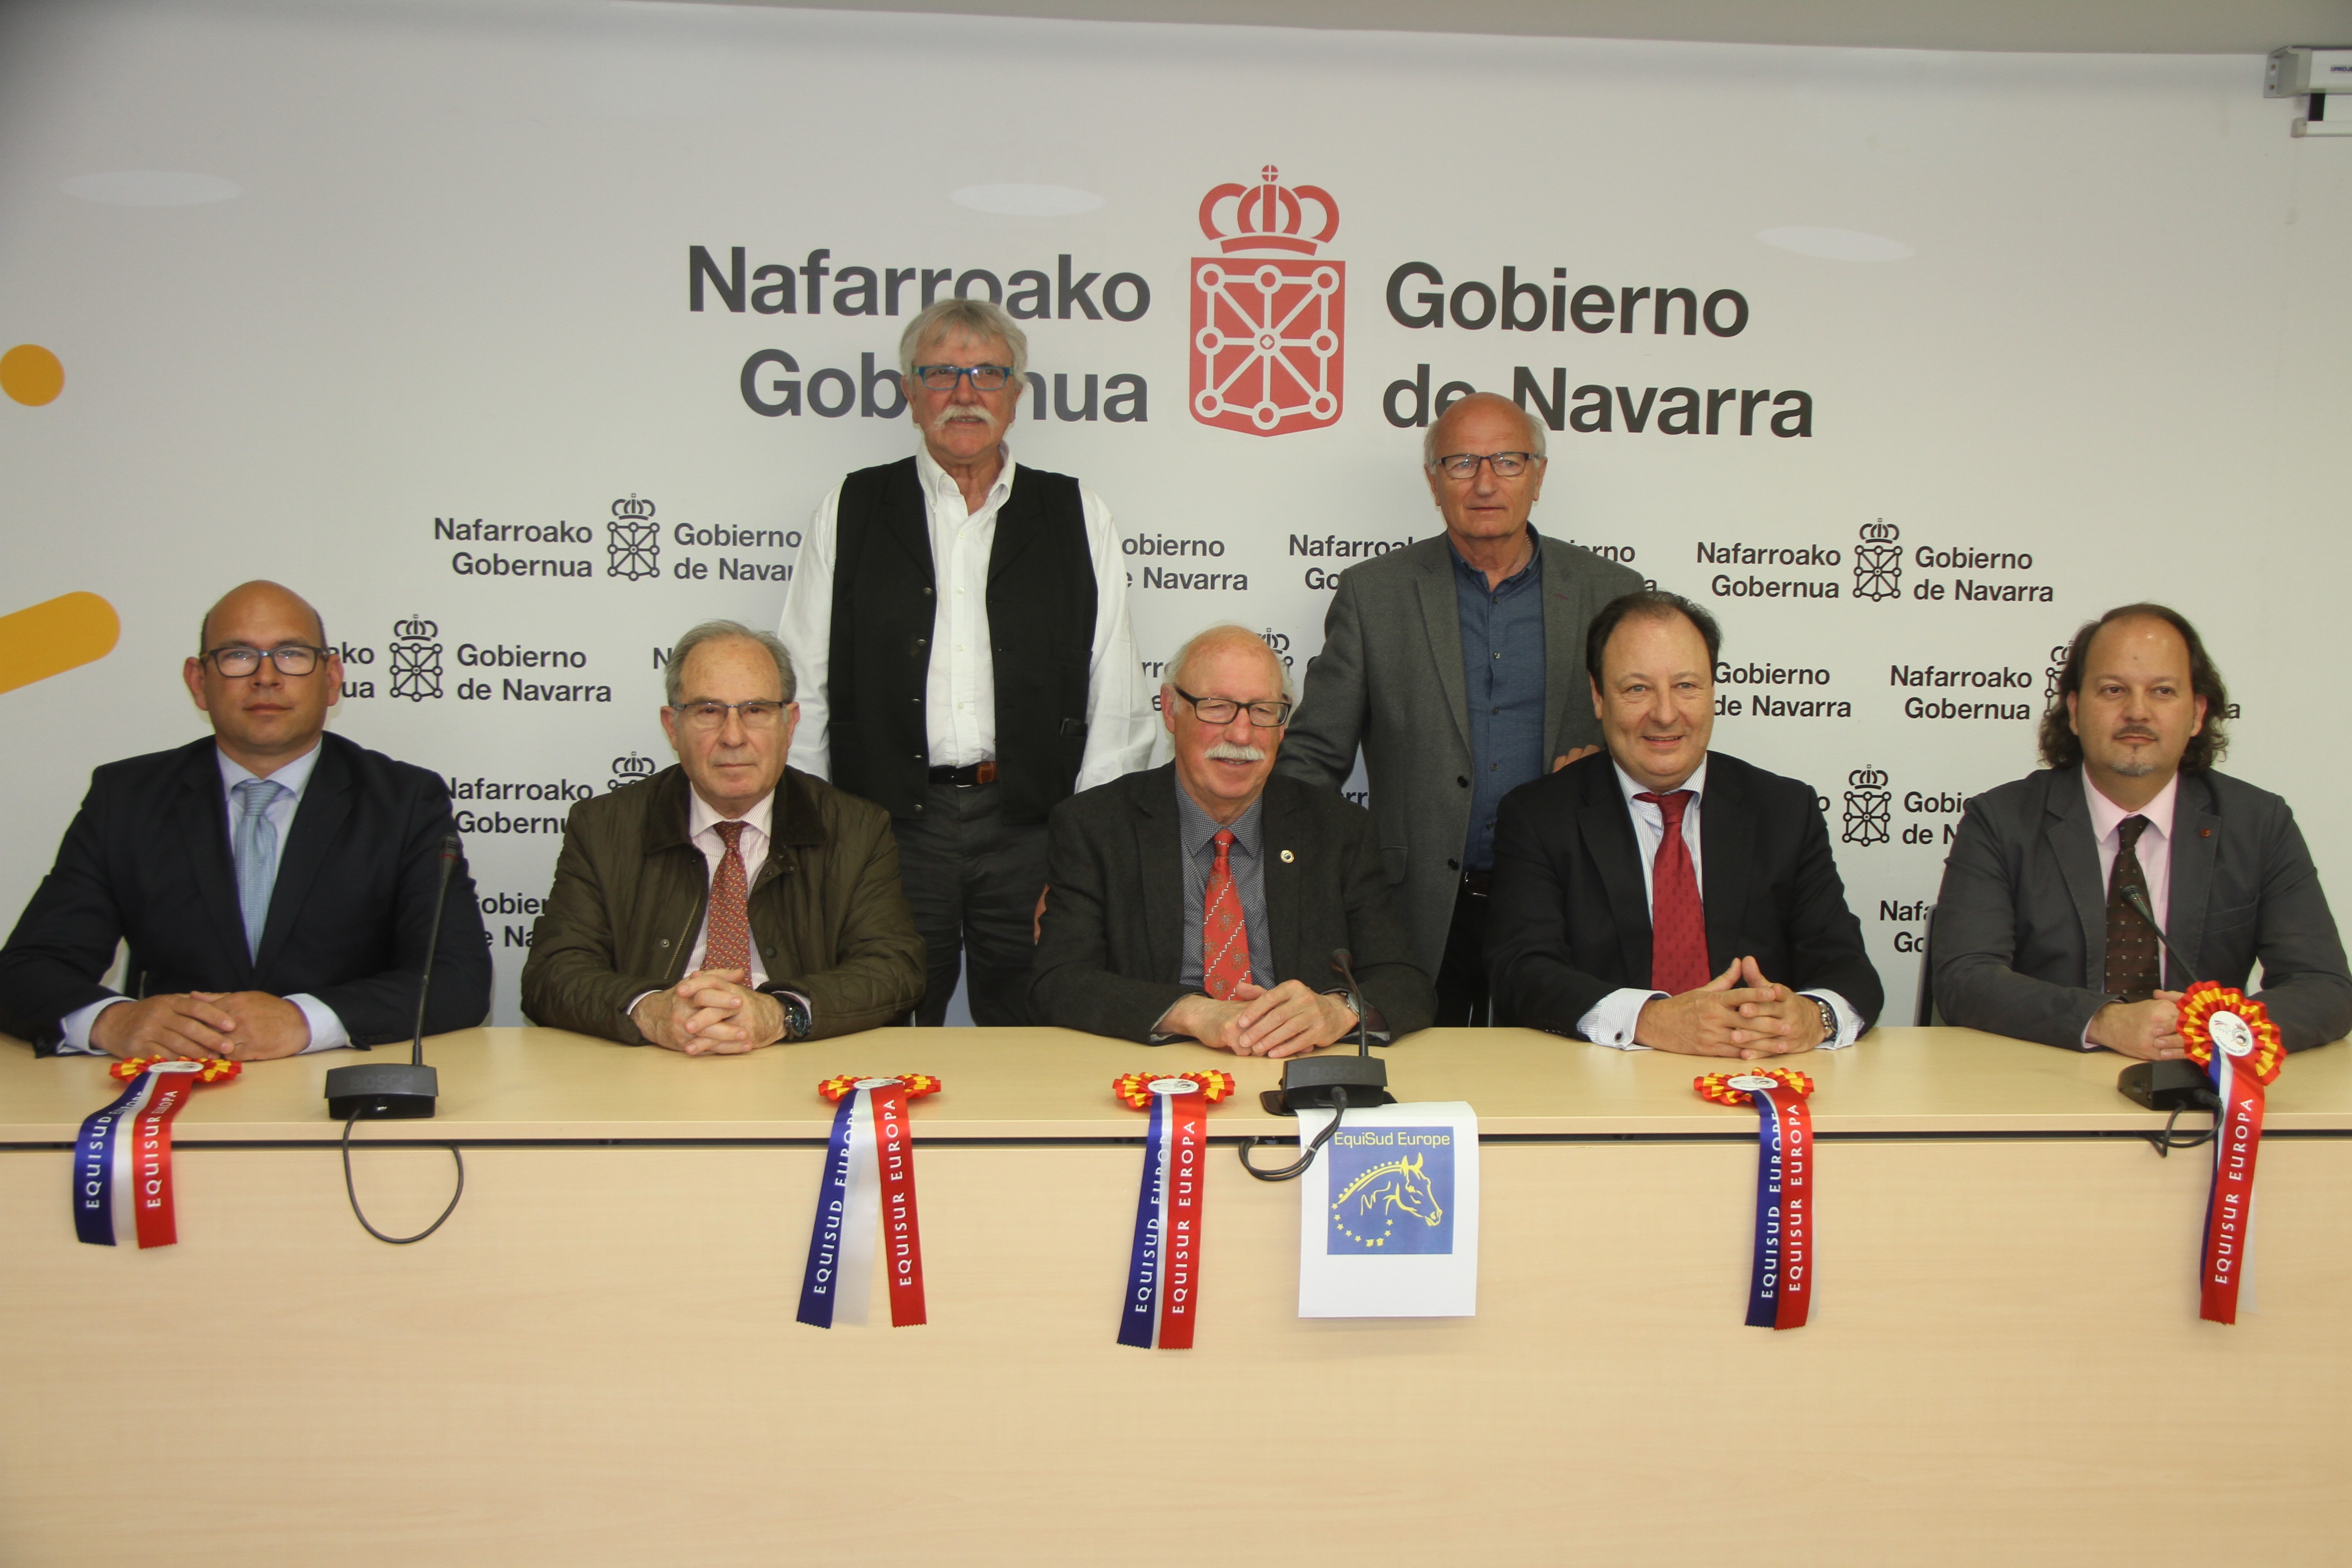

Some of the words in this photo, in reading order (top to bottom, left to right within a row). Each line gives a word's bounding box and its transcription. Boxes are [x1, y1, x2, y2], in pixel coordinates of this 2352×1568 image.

[689, 245, 1151, 321] Nafarroako
[1386, 261, 1749, 338] Gobierno
[740, 349, 1147, 423] Gobnua
[1513, 366, 1812, 437] Navarra
[435, 517, 593, 544] Nafarroako
[674, 523, 802, 548] Gobierno
[1122, 533, 1225, 557] obierno
[1289, 534, 1413, 557] Nafarro
[1697, 542, 1841, 566] Nafarroako
[1915, 546, 2033, 569] Gobierno
[452, 552, 592, 578] Gobernua
[674, 557, 708, 580] de
[1144, 567, 1248, 591] Navarra
[1712, 574, 1839, 599] Gobernua
[1913, 578, 1945, 600] de
[1955, 579, 2053, 602] Navarra
[457, 643, 586, 668] Gobierno
[1715, 662, 1830, 685] Gobierno
[1890, 665, 2032, 688] Nafarroako
[457, 678, 491, 701] de
[503, 678, 612, 702] Navarra
[1714, 695, 1742, 716] de
[1752, 695, 1851, 718] Navarra
[1905, 697, 2030, 720] Gobernua
[1904, 791, 1971, 813] Gobi
[456, 810, 566, 834] Gobern
[1902, 823, 1933, 845] de
[883, 1099, 903, 1181] EUROPA
[1334, 1132, 1393, 1148] EquiSud
[1397, 1132, 1450, 1148] Europe
[1786, 1104, 1803, 1186] EUROPA
[86, 1116, 112, 1209] EQUISUD
[145, 1116, 162, 1208] EQUISUR
[1179, 1121, 1196, 1206] EUROPA
[2215, 1193, 2238, 1284] EQUISUR
[2229, 1098, 2253, 1181] EUROPA
[814, 1200, 843, 1294] EQUISUD
[892, 1192, 912, 1286] EQUISUR
[1761, 1205, 1780, 1298] EQUISUD
[1789, 1198, 1803, 1292] EQUISUR
[1135, 1218, 1159, 1313] EQUISUD
[1172, 1220, 1190, 1314] EQUISUR
